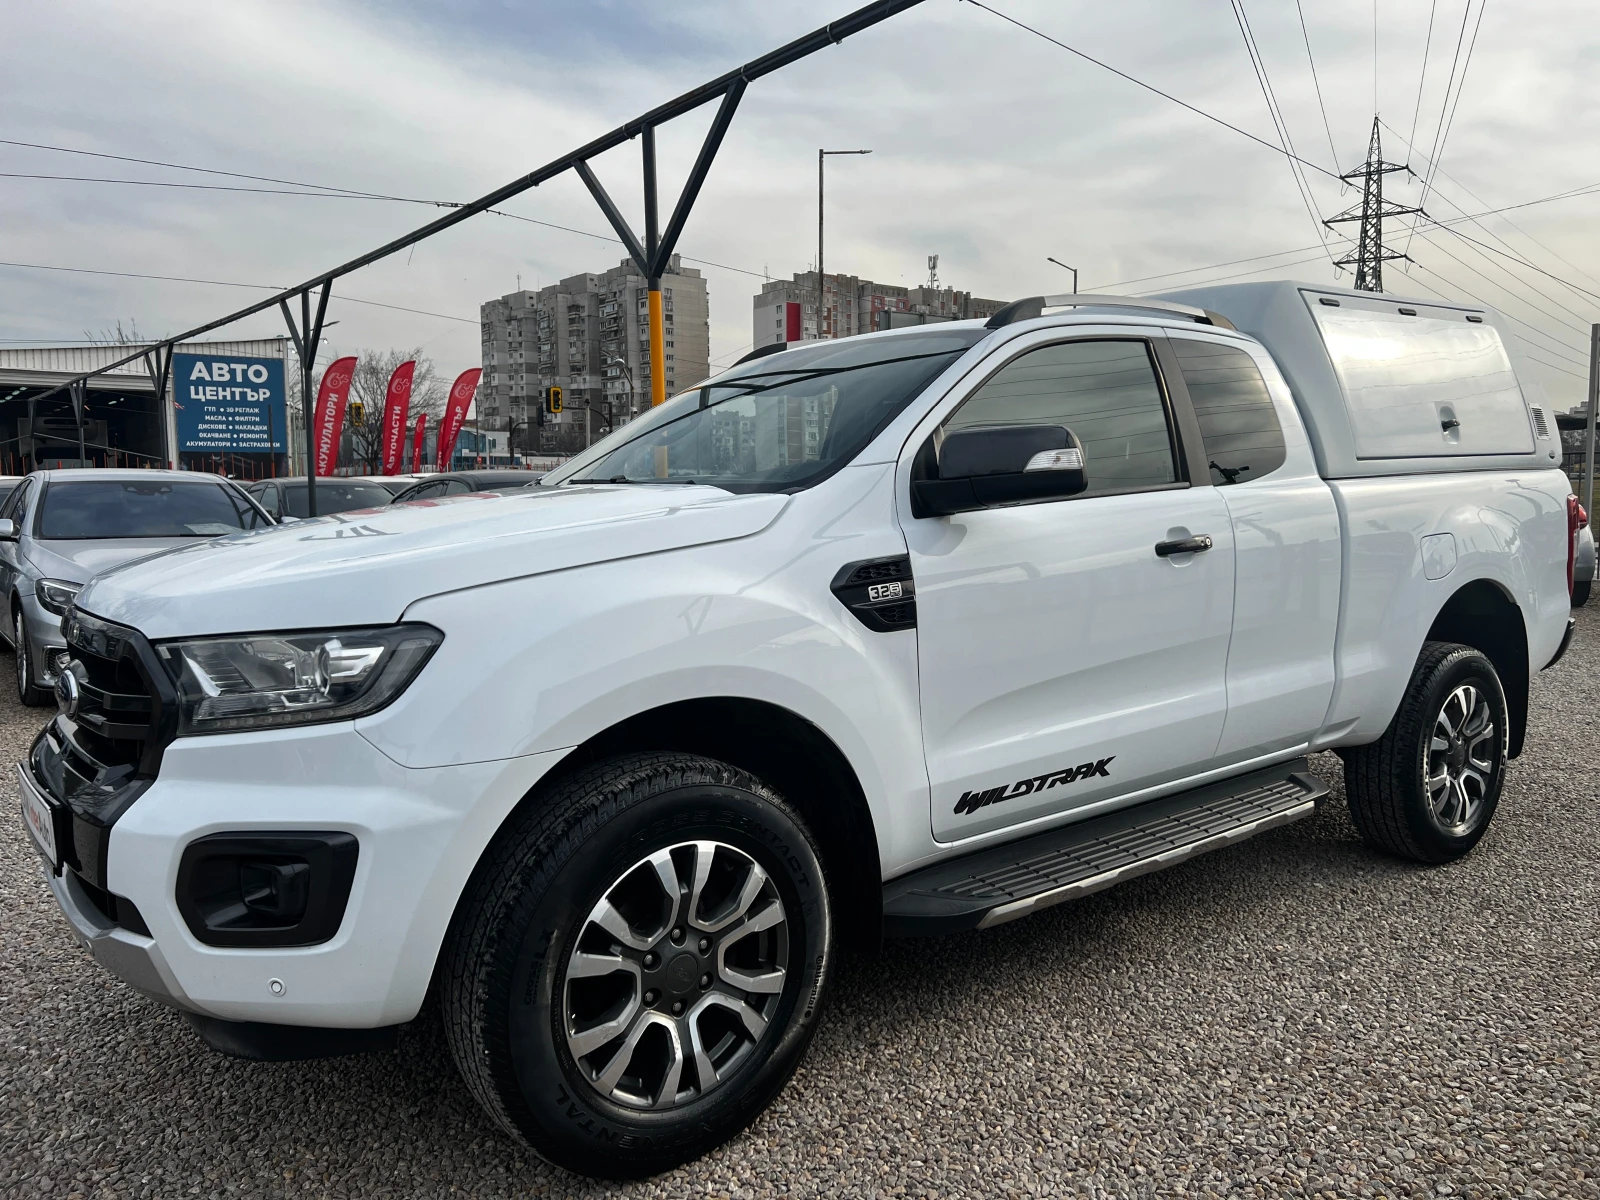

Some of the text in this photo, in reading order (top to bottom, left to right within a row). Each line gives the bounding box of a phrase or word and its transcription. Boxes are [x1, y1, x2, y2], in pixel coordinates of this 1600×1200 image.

[189, 361, 269, 384] АВТО
[189, 385, 271, 402] ЦЕНТЪР
[318, 393, 339, 475] АКУМУЛАТОРИ
[386, 405, 402, 469] АВТОЧАСТИ
[953, 755, 1117, 816] WILDTRAK
